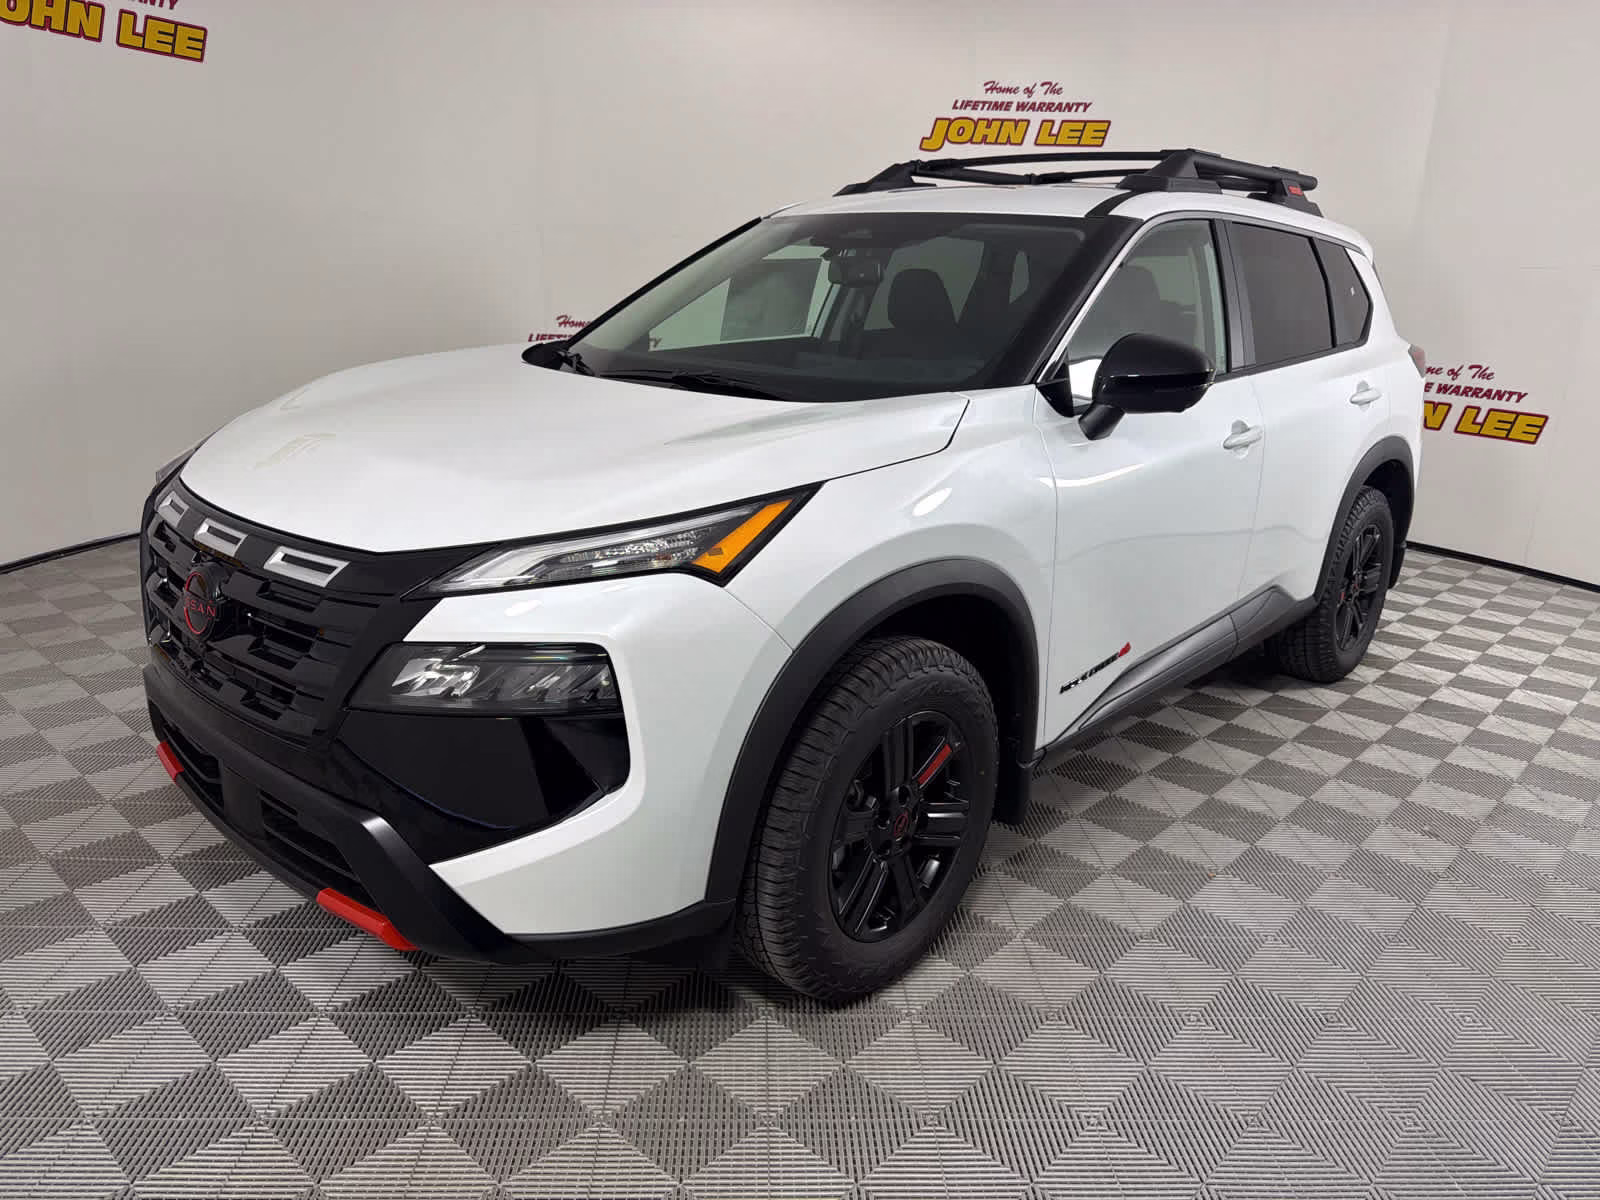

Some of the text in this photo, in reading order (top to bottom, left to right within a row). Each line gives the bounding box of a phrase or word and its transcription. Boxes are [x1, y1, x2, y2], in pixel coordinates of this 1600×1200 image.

[0, 0, 208, 62] OHN LEE
[983, 80, 1063, 98] Home of The
[952, 99, 1093, 113] LIFETIME WARRANTY
[919, 117, 1111, 152] JOHN LEE
[1447, 364, 1464, 380] of
[1468, 364, 1495, 380] The
[1436, 383, 1528, 403] WARRANTY
[1454, 405, 1549, 445] LEE
